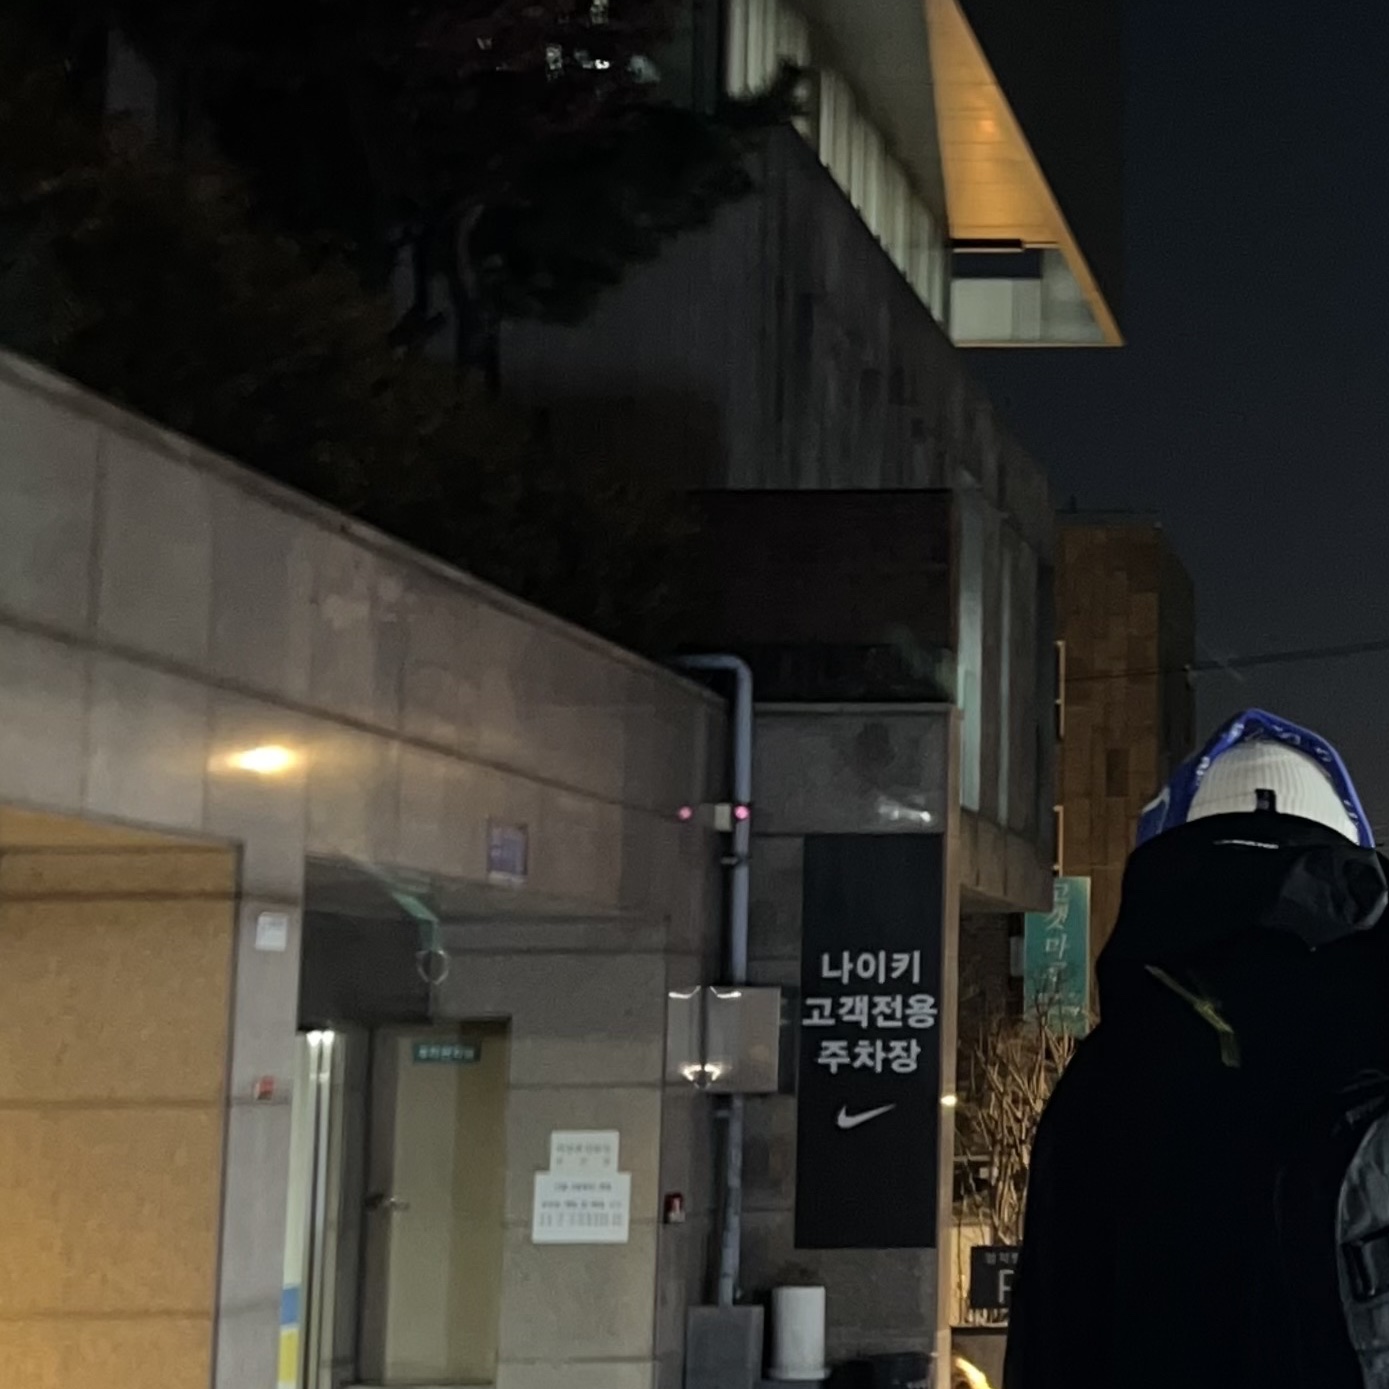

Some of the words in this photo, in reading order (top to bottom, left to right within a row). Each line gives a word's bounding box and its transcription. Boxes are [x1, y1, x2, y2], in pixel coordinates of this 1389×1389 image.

[821, 950, 921, 985] 나이키
[802, 993, 938, 1029] 고객전용
[817, 1038, 921, 1074] 주차장
